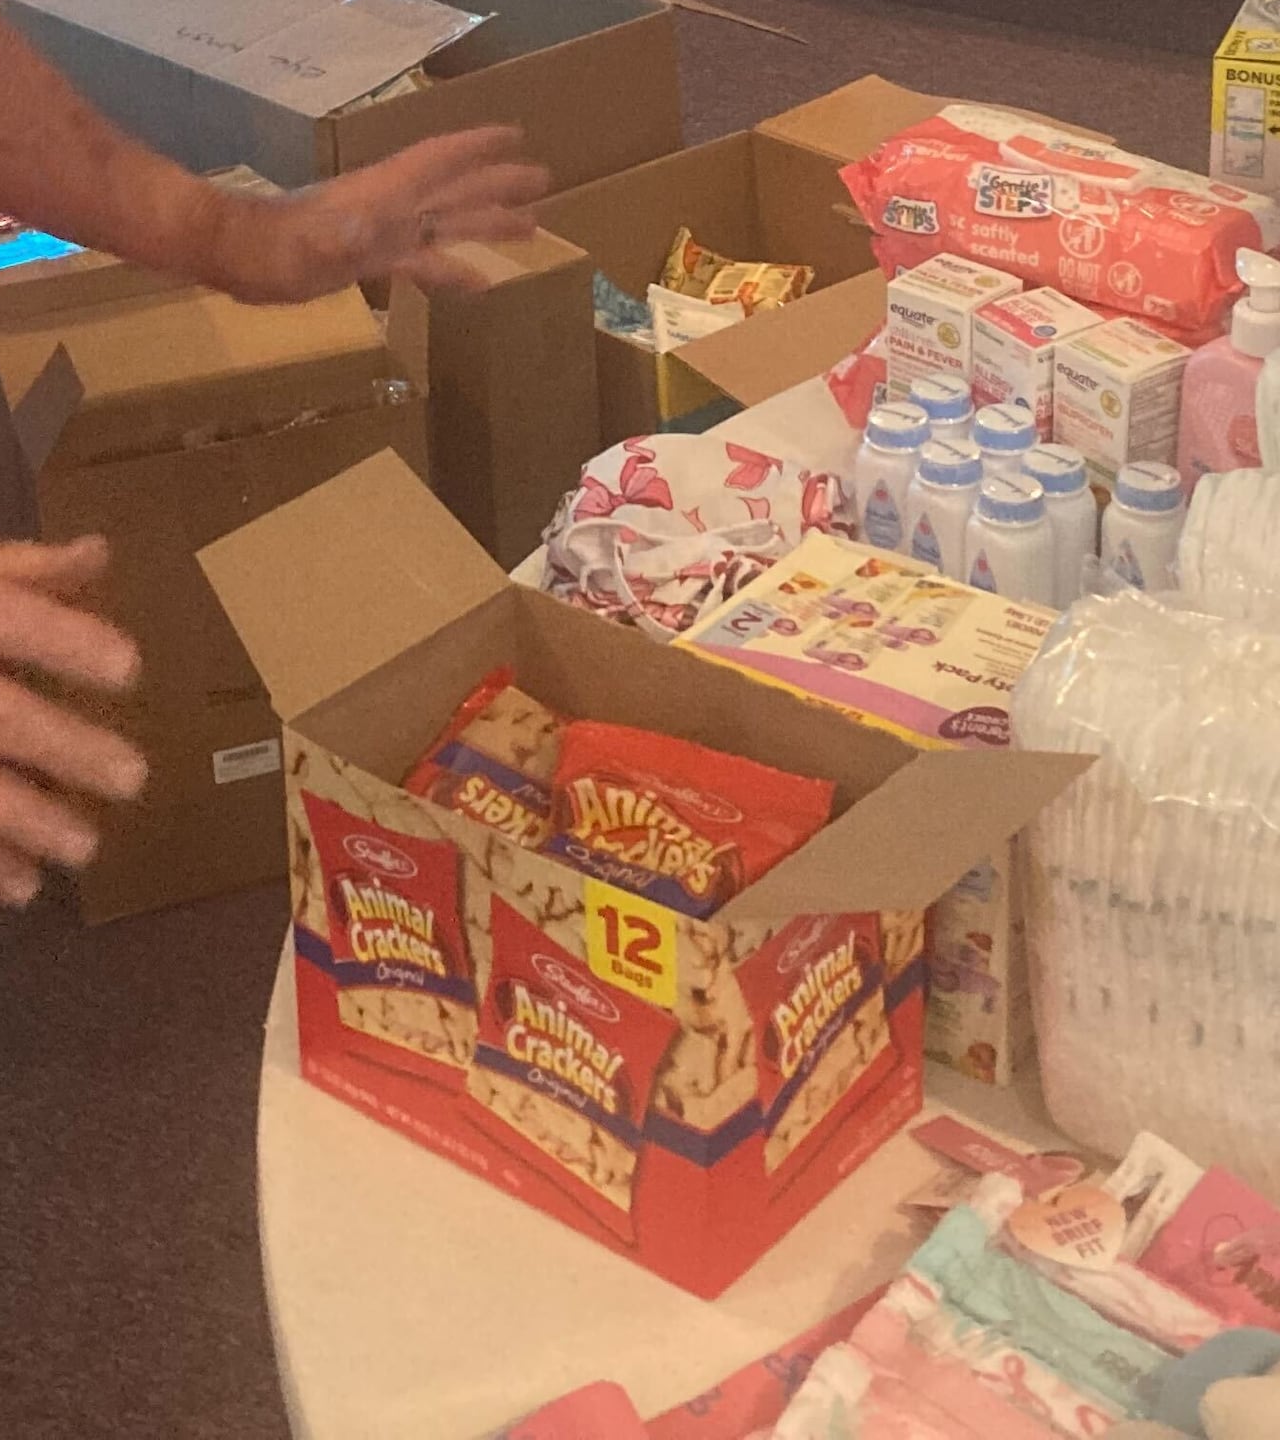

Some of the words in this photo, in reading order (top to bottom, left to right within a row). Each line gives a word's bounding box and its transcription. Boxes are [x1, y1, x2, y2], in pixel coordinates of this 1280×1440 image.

[977, 182, 1051, 218] STEPS
[988, 173, 1041, 197] Gentle
[970, 223, 1020, 246] softly
[970, 242, 1041, 269] scented
[1057, 257, 1077, 280] DO
[1076, 260, 1102, 283] NOT
[889, 302, 938, 326] equate
[888, 335, 916, 354] PAIN
[917, 344, 926, 357] &
[926, 348, 963, 370] FEVER
[1056, 361, 1100, 392] equate
[933, 658, 994, 687] Pack
[572, 776, 737, 864] Animal
[565, 843, 657, 889] Original
[340, 876, 435, 944] Animal
[350, 919, 447, 978] Crackers
[596, 904, 663, 976] 12
[376, 962, 425, 988] Original
[610, 958, 654, 990] Bags
[773, 929, 858, 1039] Animal
[513, 983, 625, 1080] Animal
[780, 964, 864, 1080] Crackers
[506, 1024, 617, 1114] Crackers
[526, 1066, 588, 1109] Original
[1044, 1206, 1088, 1231] NEW
[1049, 1217, 1105, 1250] BRIEF
[1074, 1235, 1109, 1261] FIT
